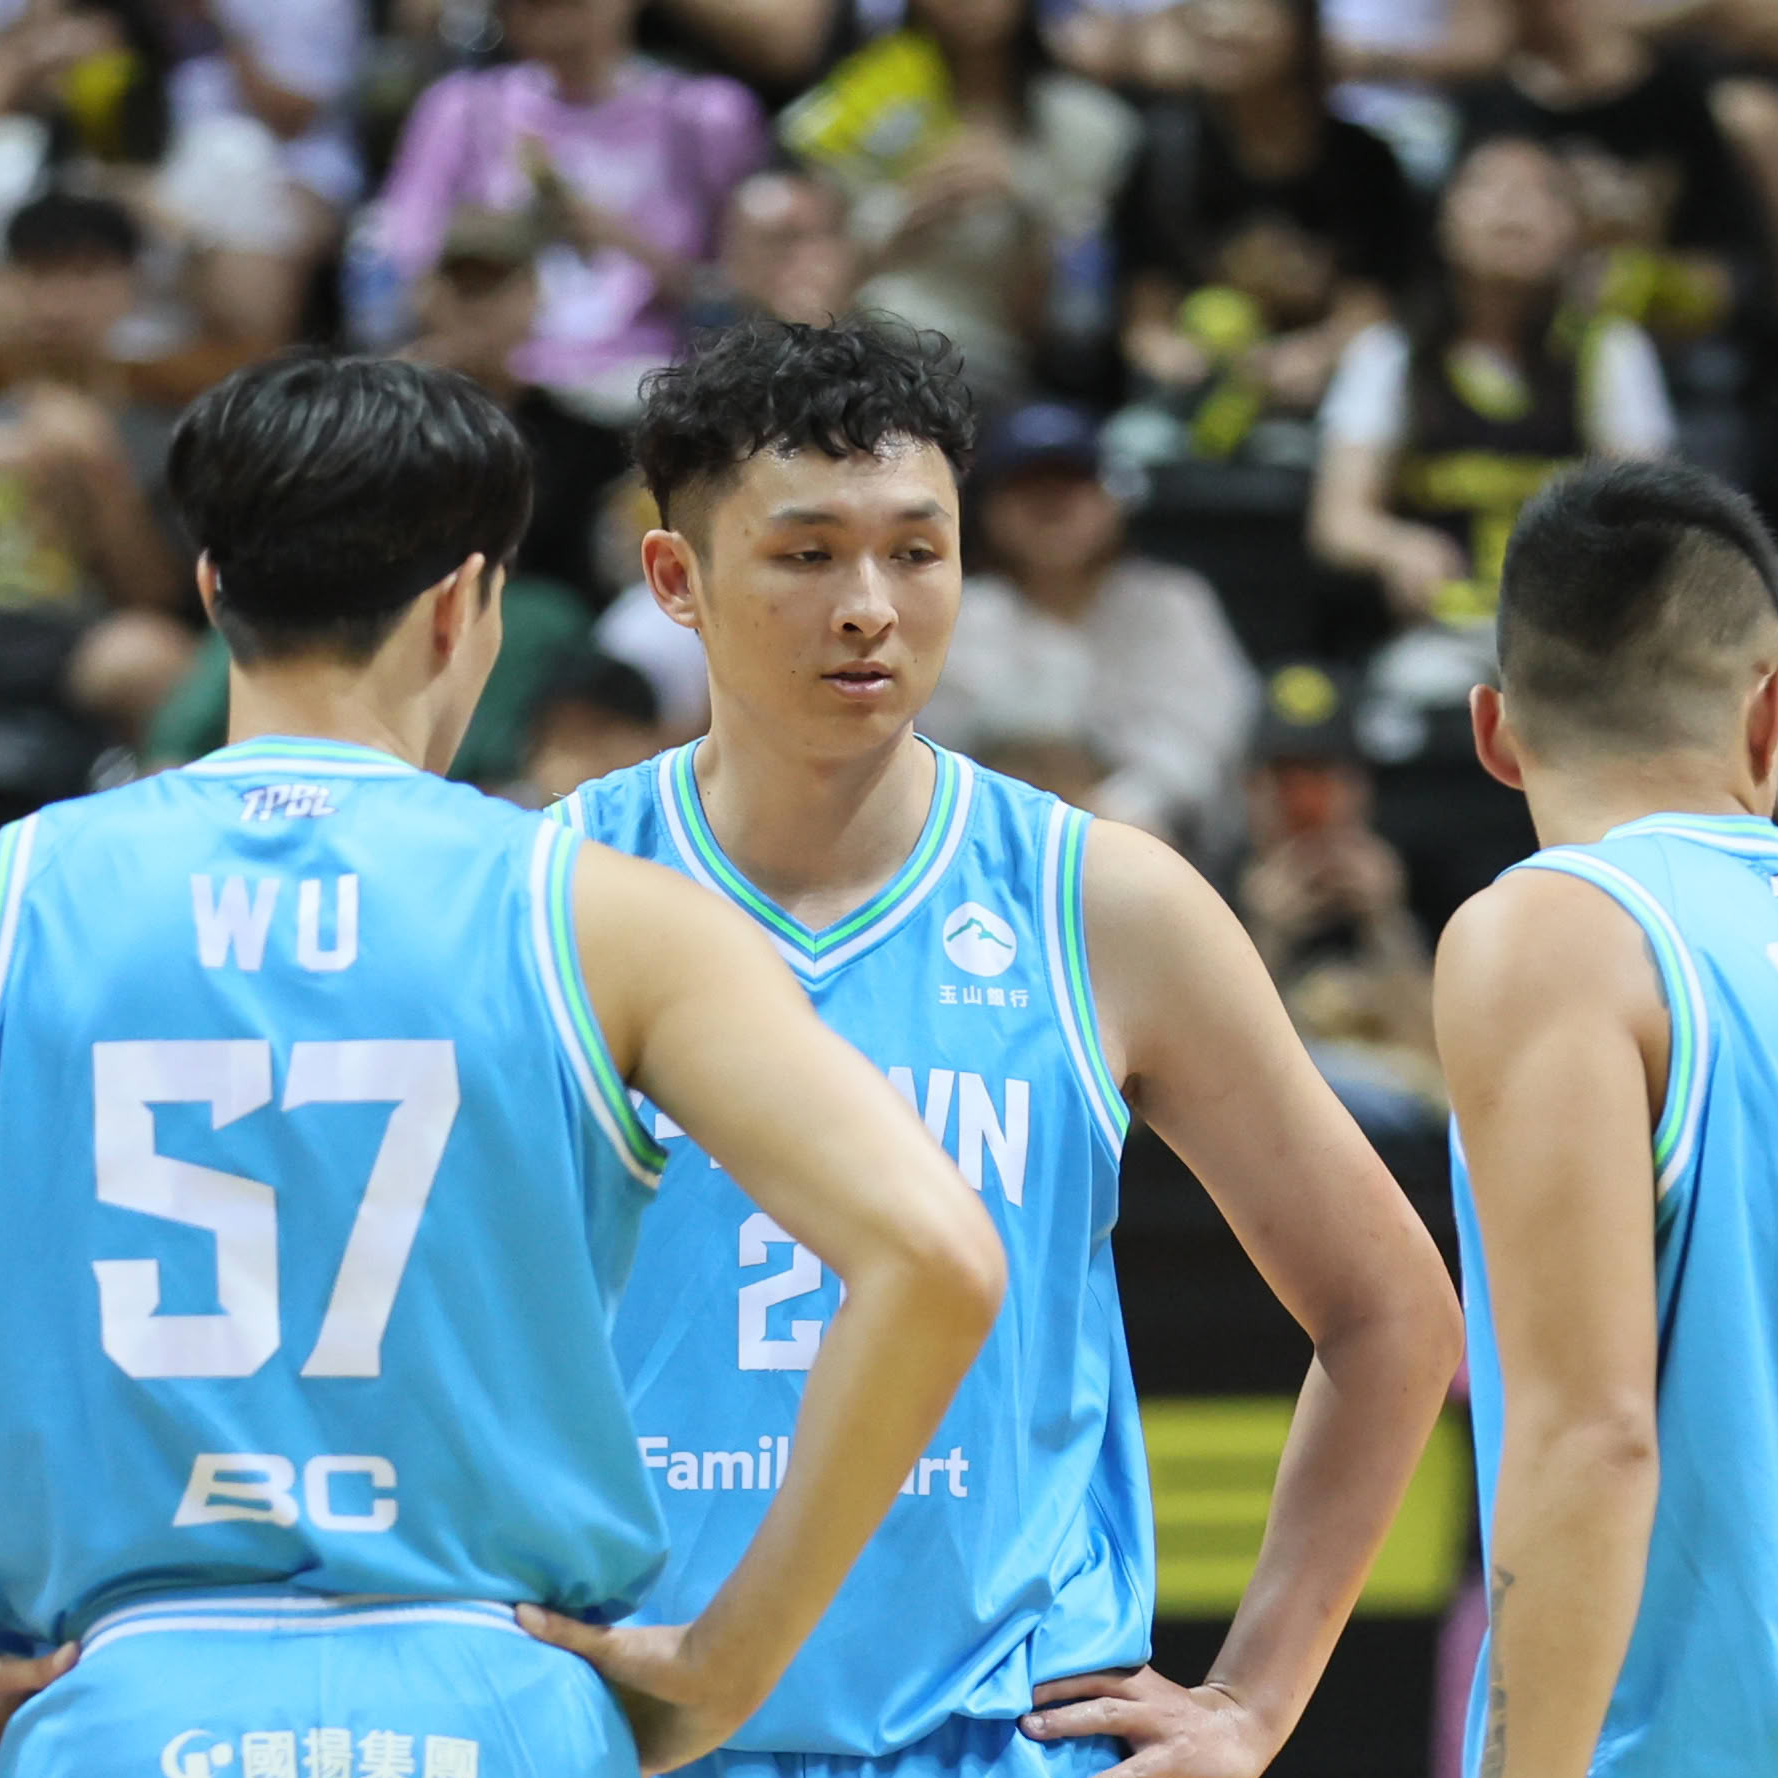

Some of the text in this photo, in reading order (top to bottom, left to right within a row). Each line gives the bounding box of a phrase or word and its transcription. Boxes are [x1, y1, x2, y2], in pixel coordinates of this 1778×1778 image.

[190, 874, 360, 972] WU
[938, 984, 1031, 1009] 玉山銀行
[93, 1040, 461, 1379] 57
[738, 1212, 849, 1371] 2
[173, 1452, 400, 1532] BC
[637, 1435, 970, 1498] Familrt
